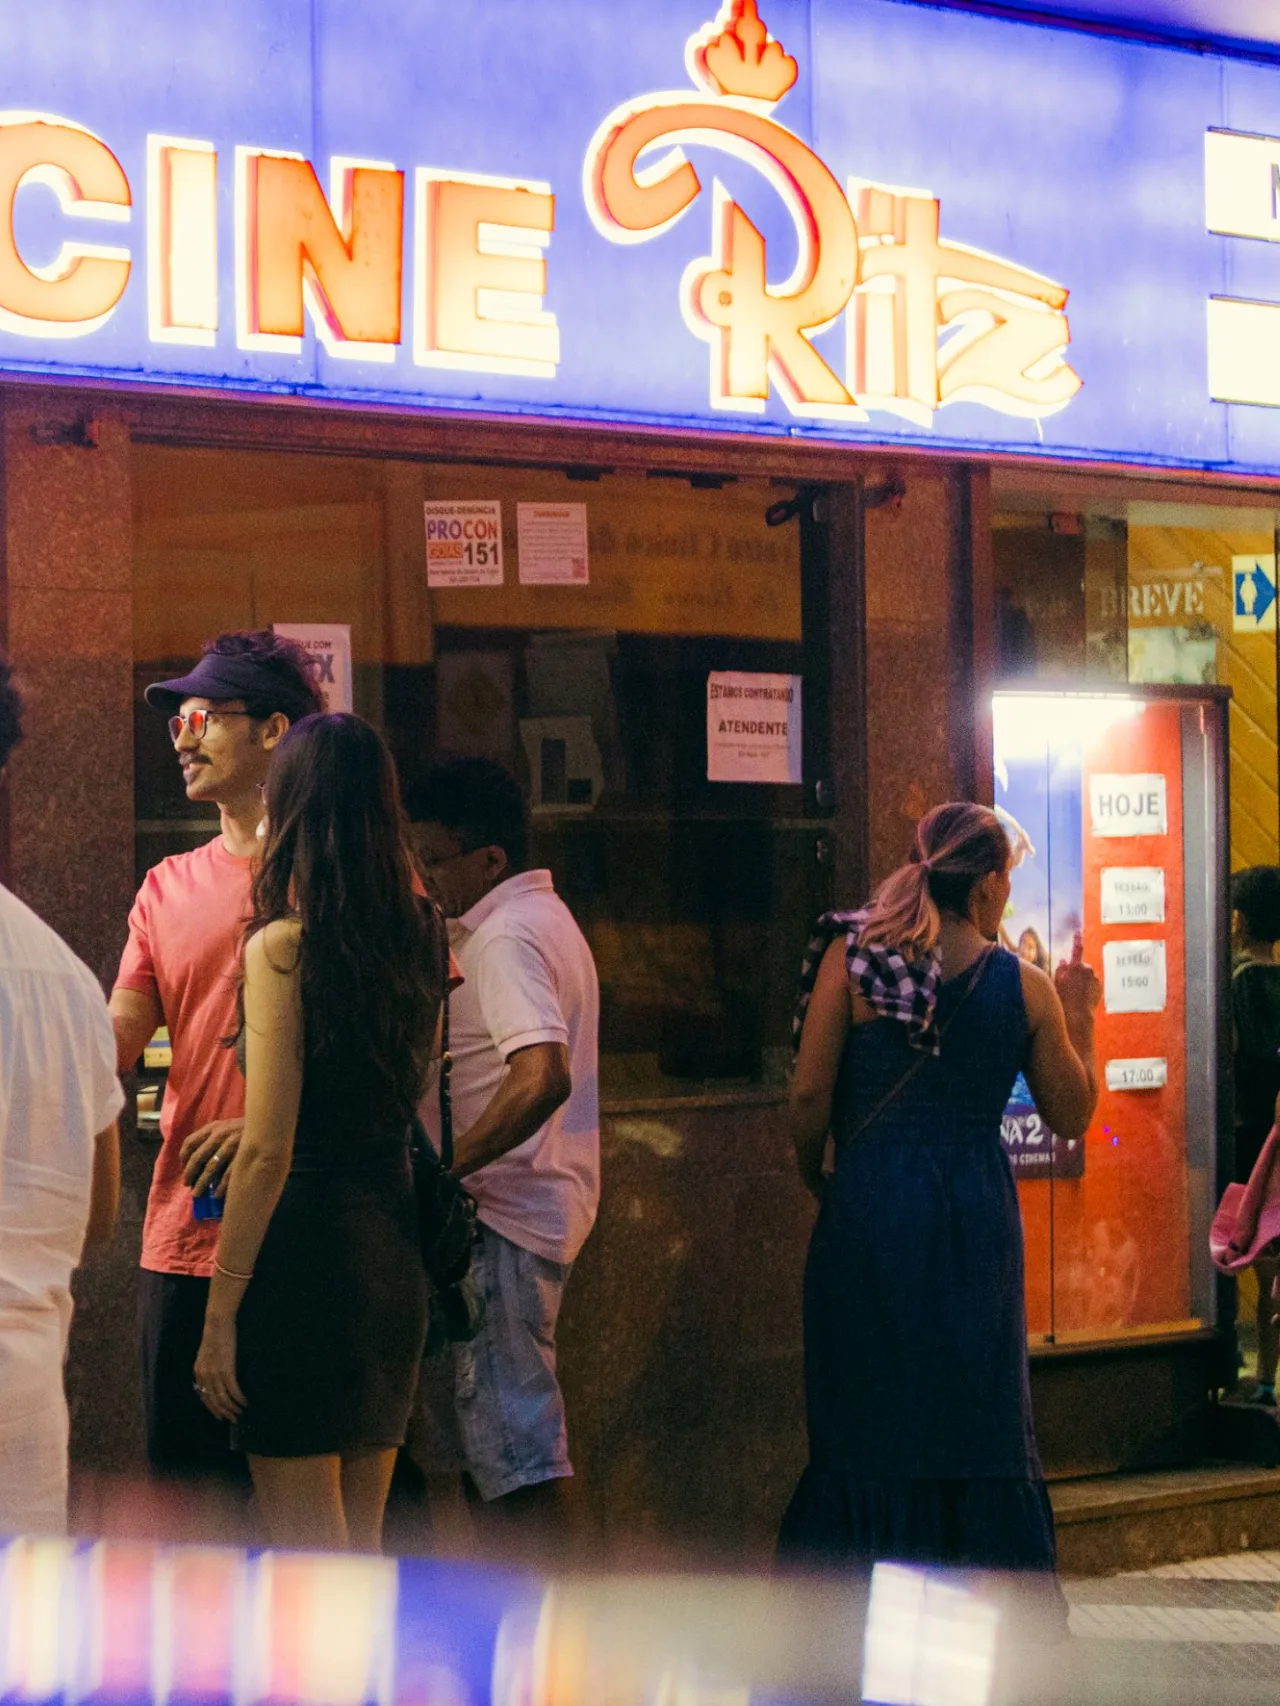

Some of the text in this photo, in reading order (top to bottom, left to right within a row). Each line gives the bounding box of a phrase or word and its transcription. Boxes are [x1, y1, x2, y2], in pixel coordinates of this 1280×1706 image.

[582, 88, 1085, 428] Ritz
[427, 519, 498, 540] PROCON
[464, 542, 499, 567] 151
[718, 719, 788, 736] ATENDENTE
[1098, 792, 1159, 818] HOJE
[1121, 976, 1148, 989] 15:00
[1122, 1068, 1154, 1083] 17:00
[1025, 1113, 1044, 1145] 2
